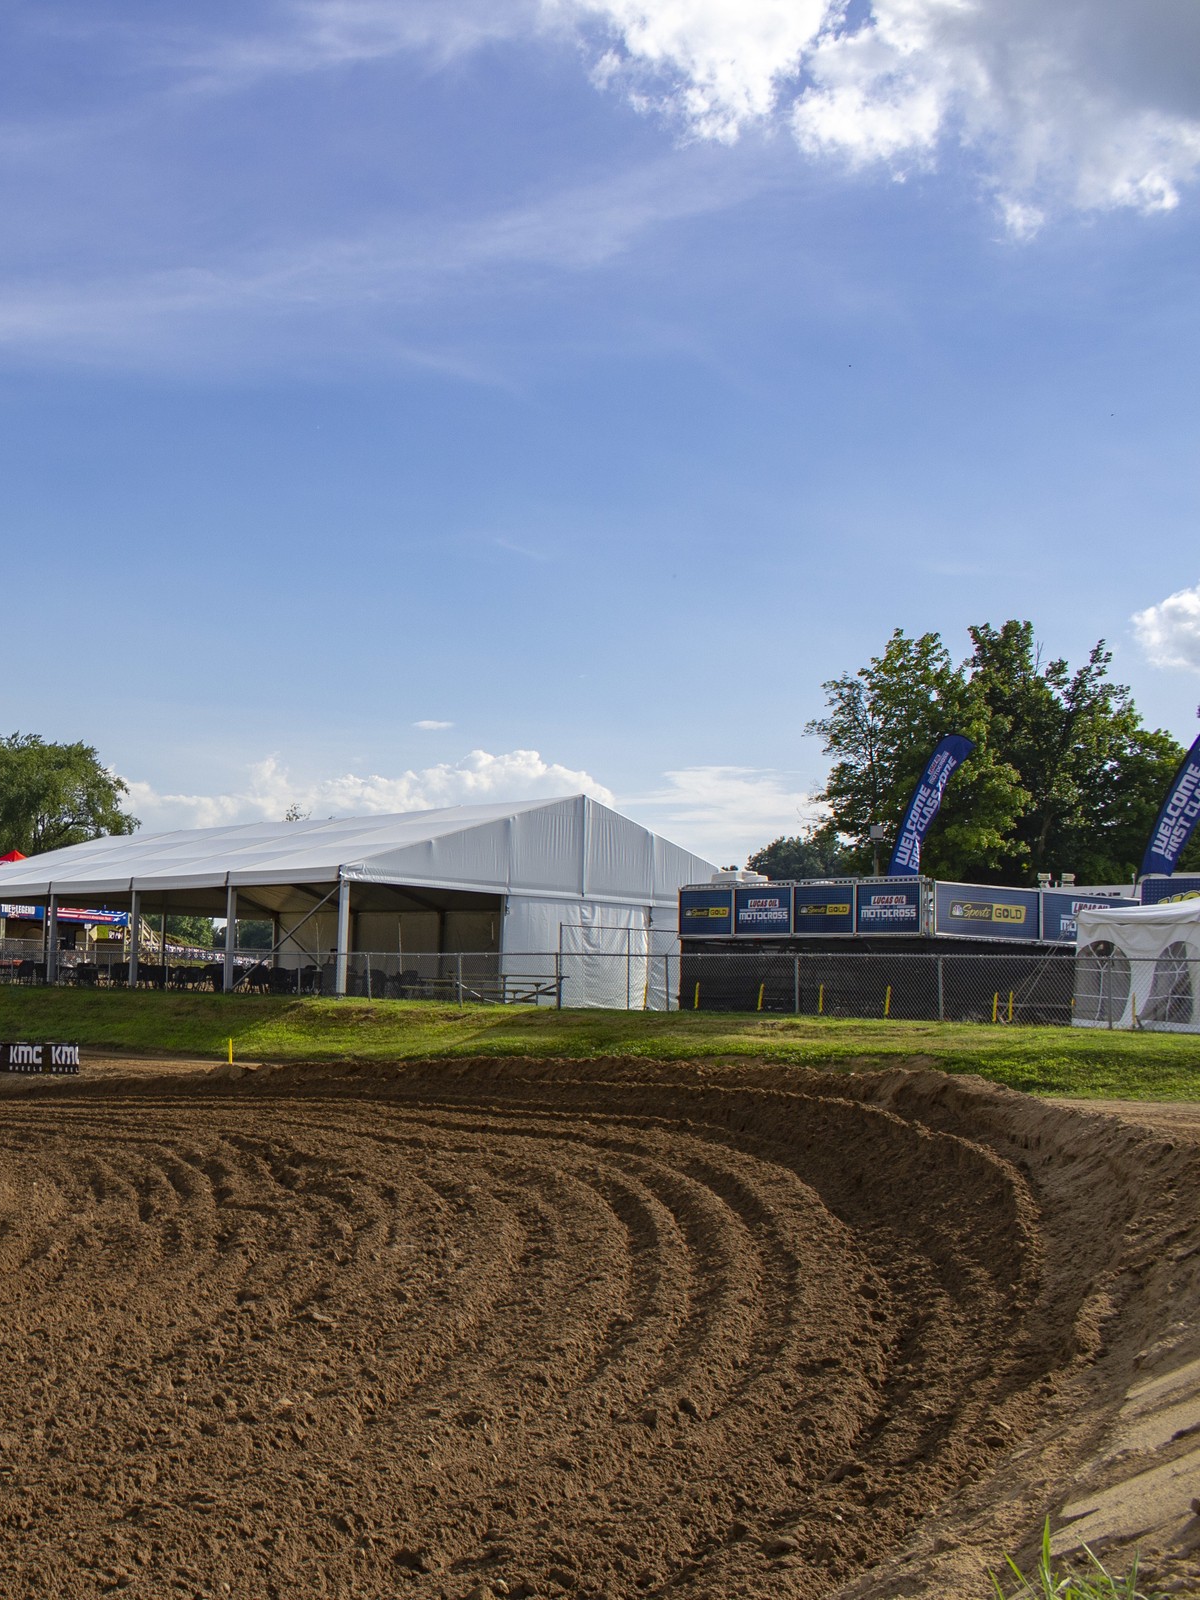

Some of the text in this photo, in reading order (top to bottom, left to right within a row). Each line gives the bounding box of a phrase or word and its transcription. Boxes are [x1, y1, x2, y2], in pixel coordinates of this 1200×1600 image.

[1151, 763, 1200, 856] WELCOME
[895, 784, 931, 866] WELCOME
[1164, 816, 1191, 861] FIRST
[749, 900, 767, 908] LUCAS
[872, 896, 905, 904] LUCAS OIL
[1, 904, 36, 915] THE LEGEND
[828, 905, 847, 913] GOLD
[861, 909, 917, 918] MOTOCROSS
[962, 903, 1022, 920] Sports GOLD
[739, 911, 788, 920] MOTOCROSS
[9, 1045, 42, 1064] KMC
